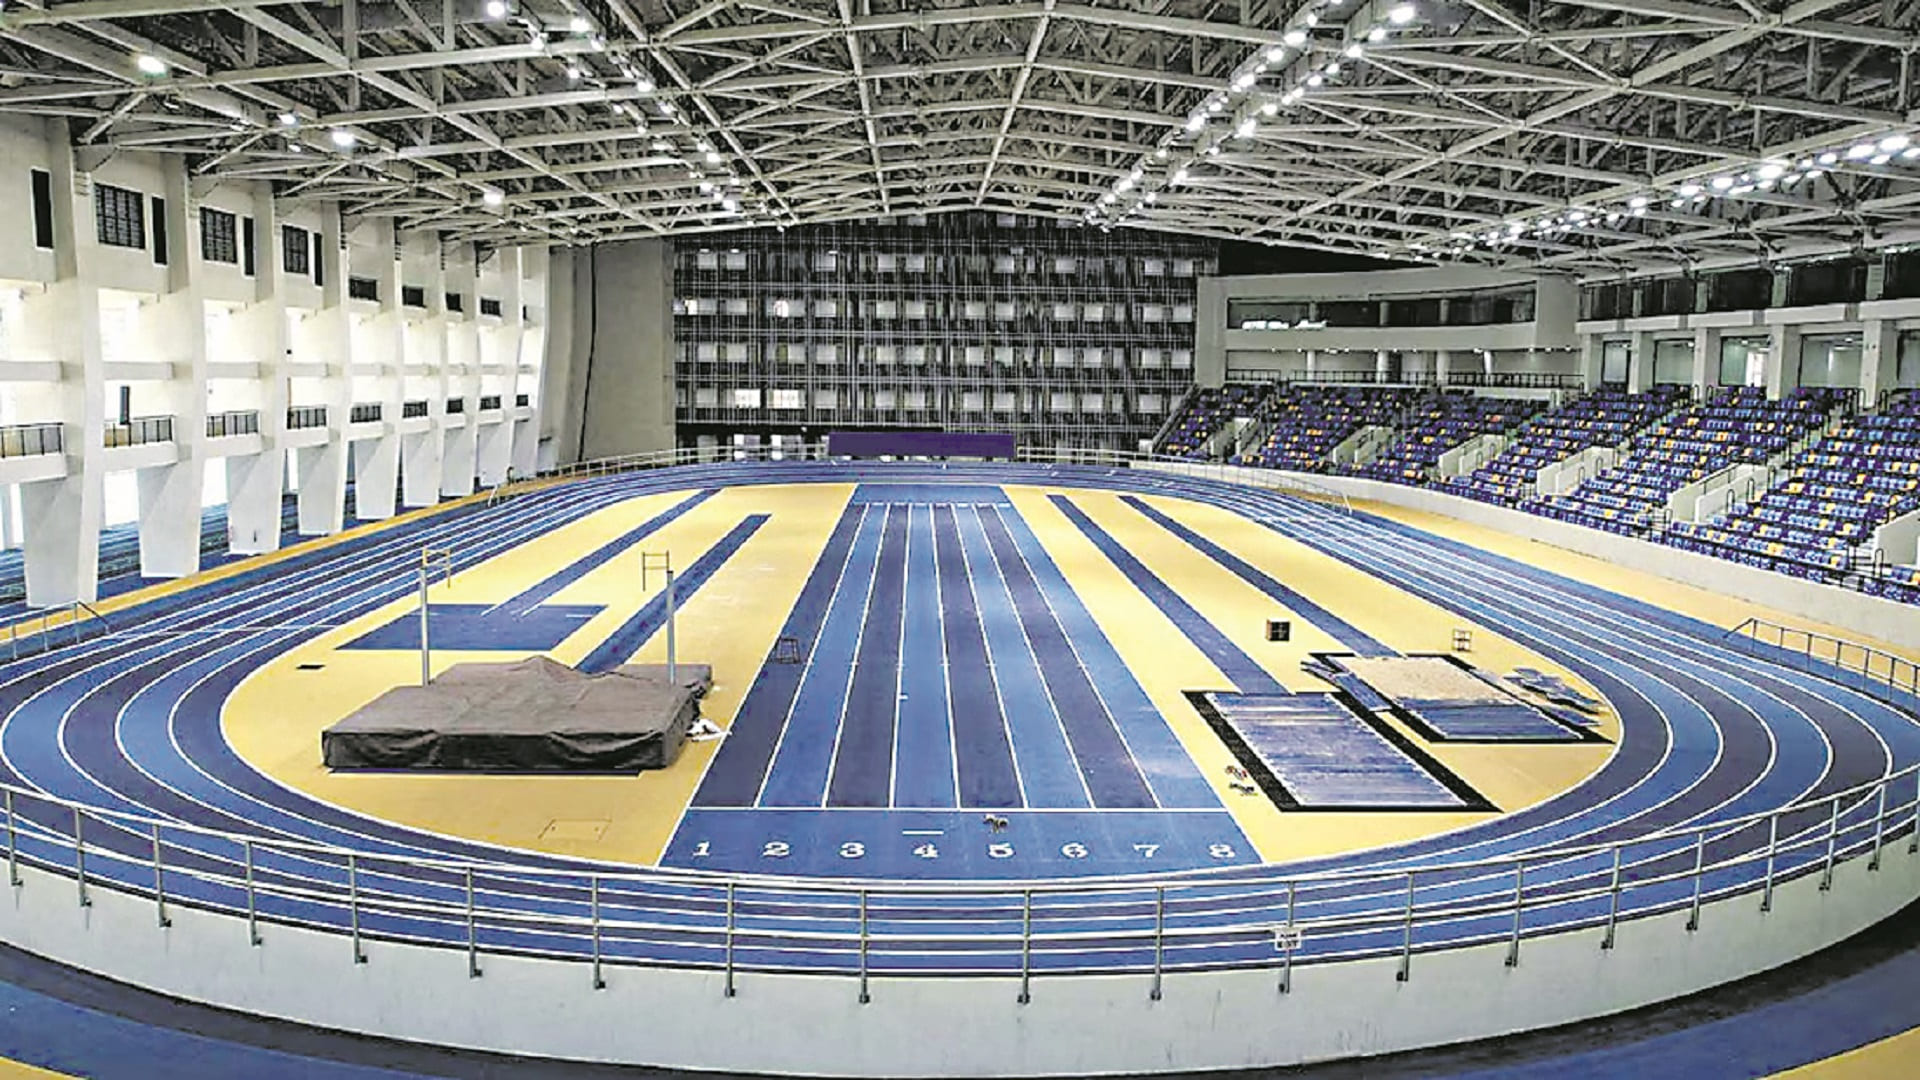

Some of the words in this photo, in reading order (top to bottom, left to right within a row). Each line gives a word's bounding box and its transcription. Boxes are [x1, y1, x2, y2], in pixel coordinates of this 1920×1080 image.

[692, 841, 711, 857] 1
[762, 841, 790, 857] 2
[839, 842, 865, 858] 3
[913, 843, 940, 858] 4
[988, 842, 1014, 858] 5
[1062, 842, 1089, 858] 6
[1132, 843, 1161, 858] 7
[1208, 843, 1236, 859] 8
